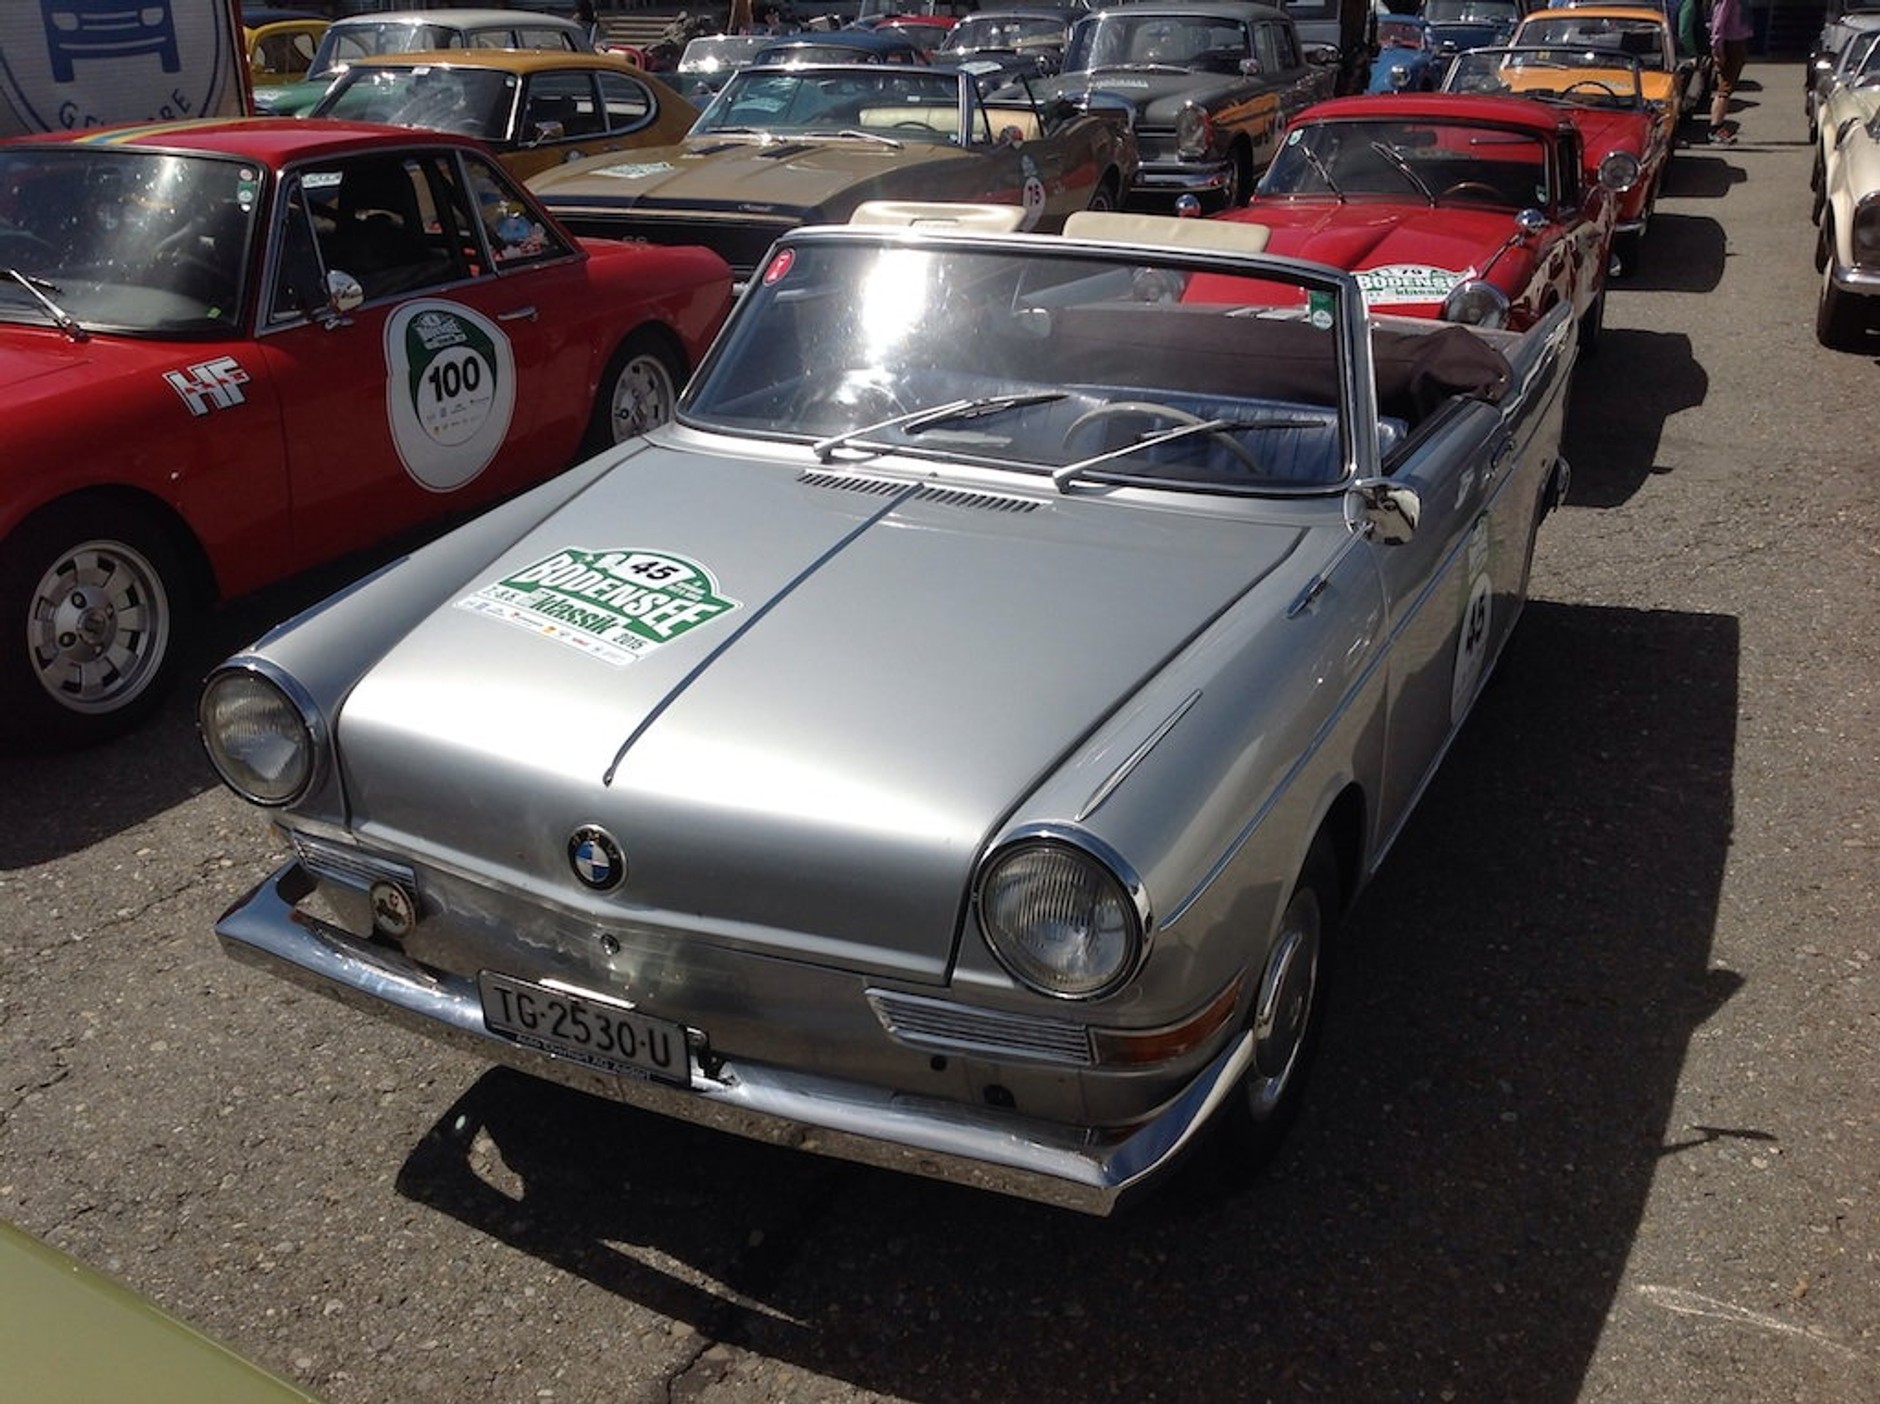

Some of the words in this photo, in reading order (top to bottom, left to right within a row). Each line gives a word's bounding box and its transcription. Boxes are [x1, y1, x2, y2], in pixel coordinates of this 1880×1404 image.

[162, 355, 251, 416] HF
[429, 355, 480, 403] 100
[510, 553, 723, 638] BODENSEE
[630, 561, 680, 580] 45
[530, 592, 620, 636] klassik
[612, 633, 649, 651] 2015
[1465, 588, 1487, 653] 45
